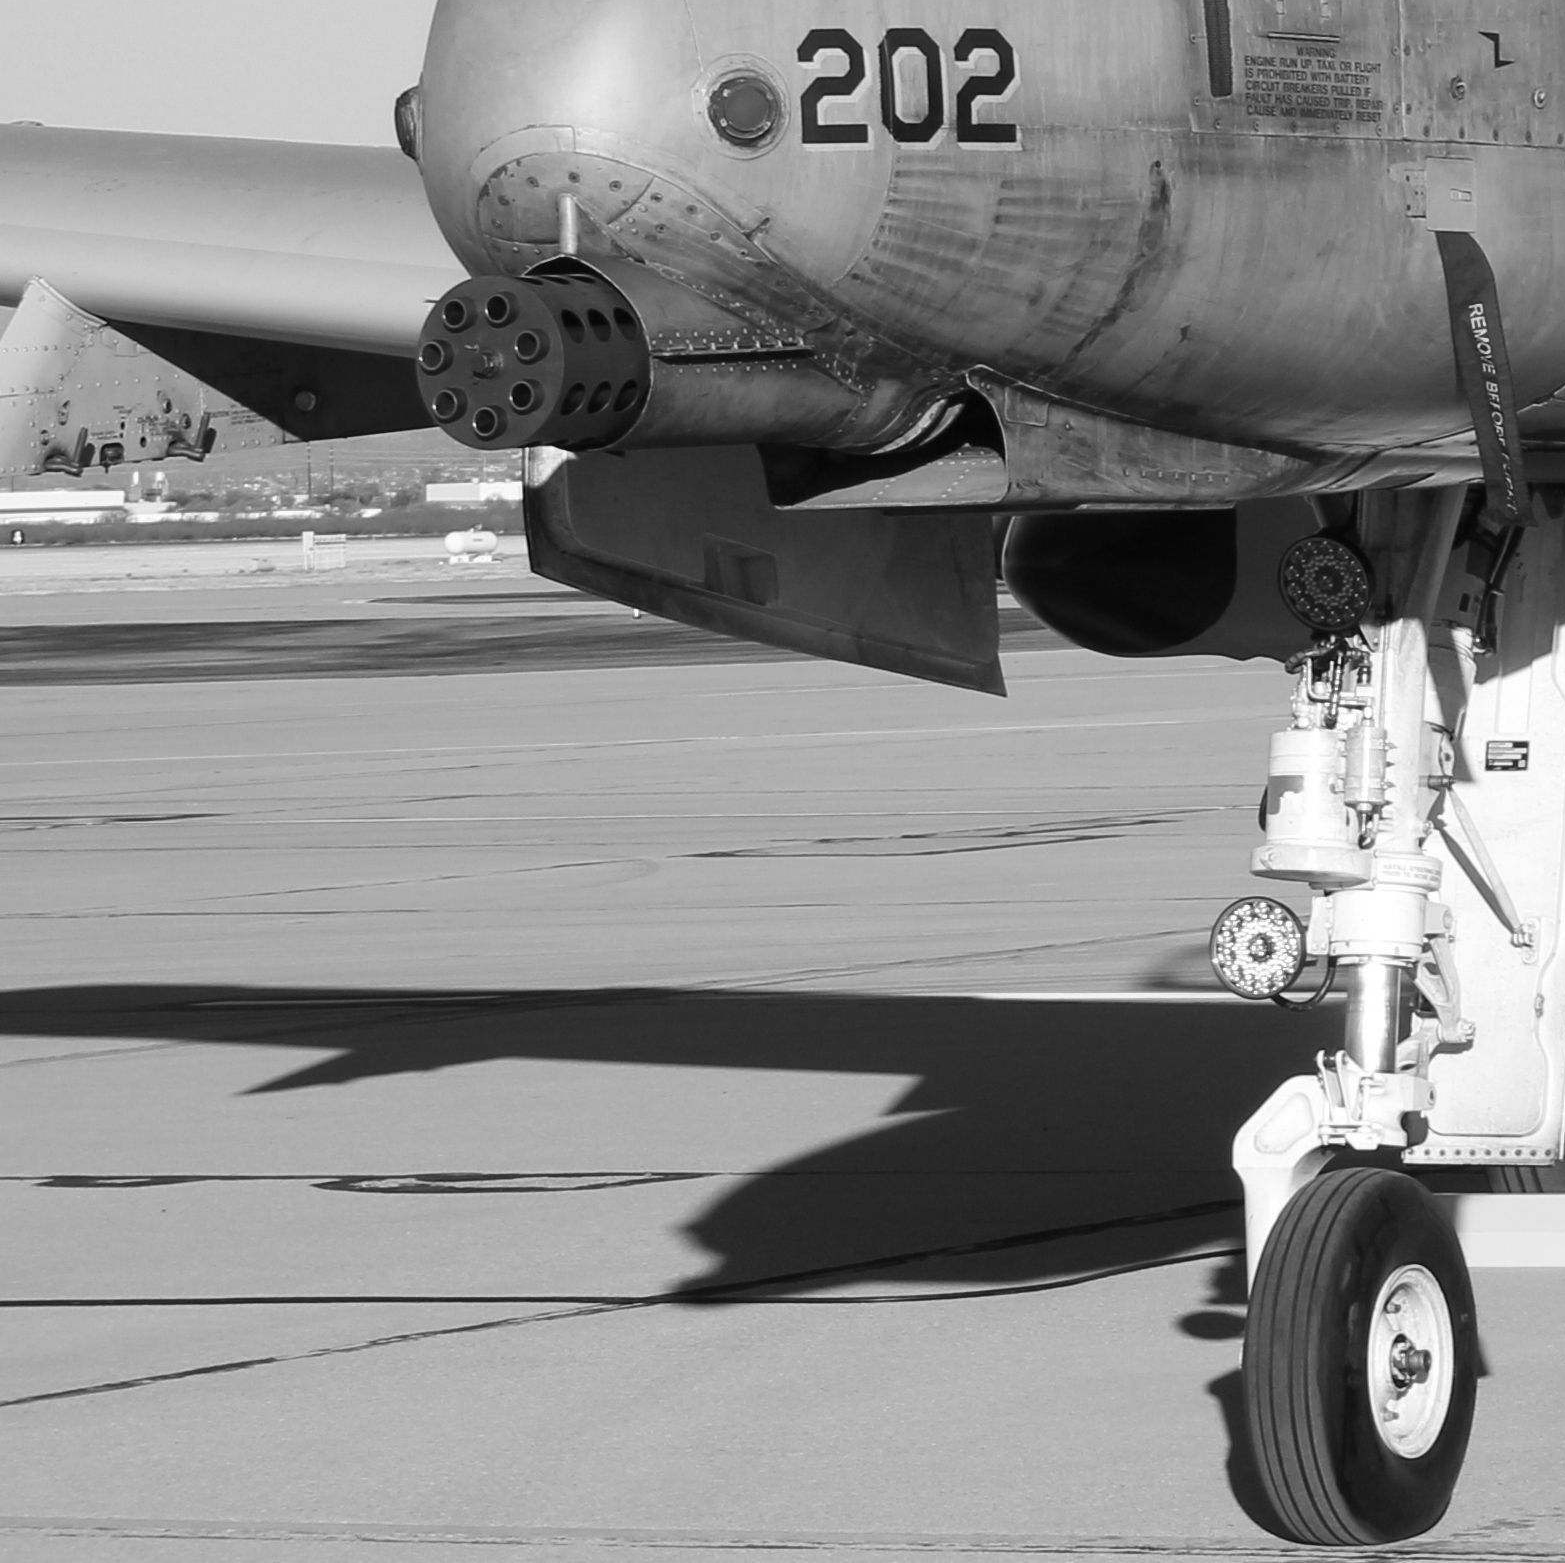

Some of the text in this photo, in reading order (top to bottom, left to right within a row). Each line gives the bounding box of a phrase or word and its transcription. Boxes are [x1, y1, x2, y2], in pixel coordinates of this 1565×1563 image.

[1296, 46, 1336, 58] WARNING
[1244, 55, 1277, 67] ENGINE
[1280, 57, 1298, 68] RUN
[1340, 61, 1352, 71] OR
[1354, 62, 1381, 74] FLIGHT
[1245, 68, 1369, 85] IS PROHIBITED WITH BATTERY
[797, 28, 1021, 150] 202
[1245, 80, 1372, 97] CIRCUIT BREAKERS PULLED IF
[1245, 92, 1273, 104] FAULT
[1275, 94, 1293, 105] HAS
[1296, 96, 1330, 107] CAUSED
[1356, 99, 1383, 110] REPAIR
[1246, 105, 1381, 123] CAUSE AND IMMEDIATELY RESET
[1467, 302, 1496, 374] REMOVE
